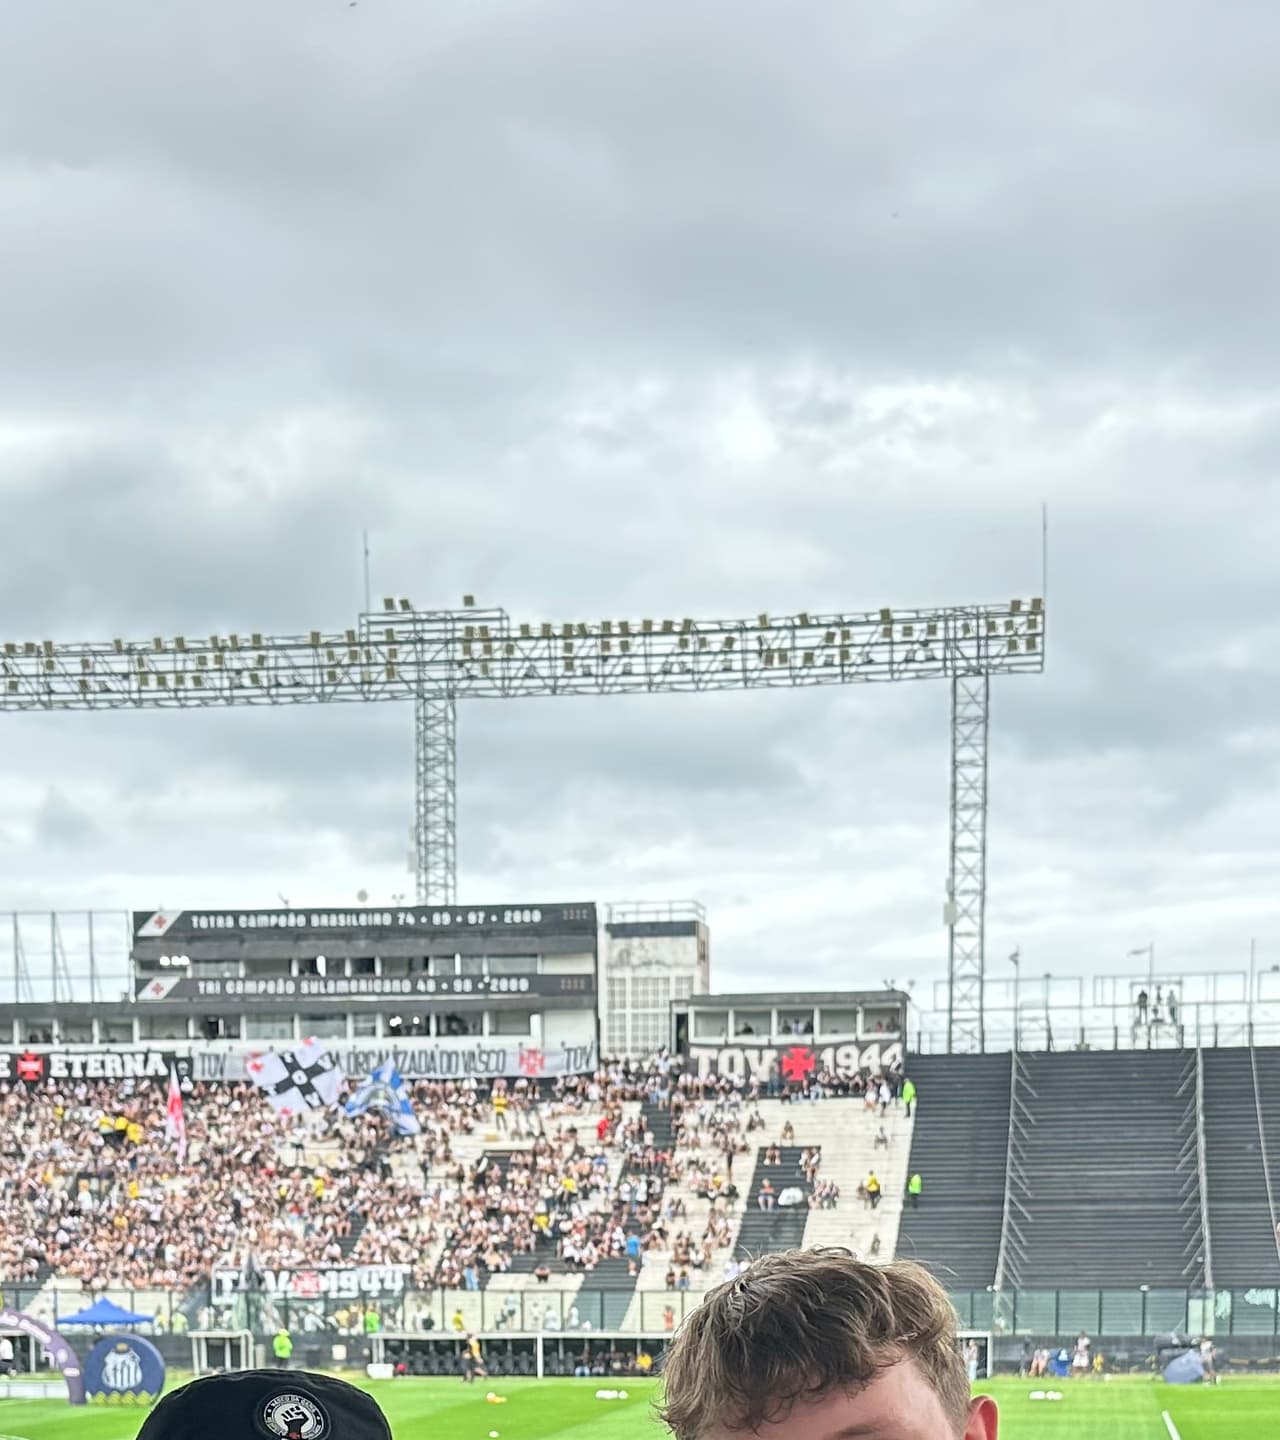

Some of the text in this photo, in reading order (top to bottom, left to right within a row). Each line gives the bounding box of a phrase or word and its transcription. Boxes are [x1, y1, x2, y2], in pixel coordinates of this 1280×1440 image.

[310, 912, 393, 928] BRASILEIRO
[503, 909, 542, 924] 2000
[48, 1051, 170, 1078] ETERNA
[461, 1048, 507, 1076] VASCO
[689, 1042, 904, 1083] TOV 1944
